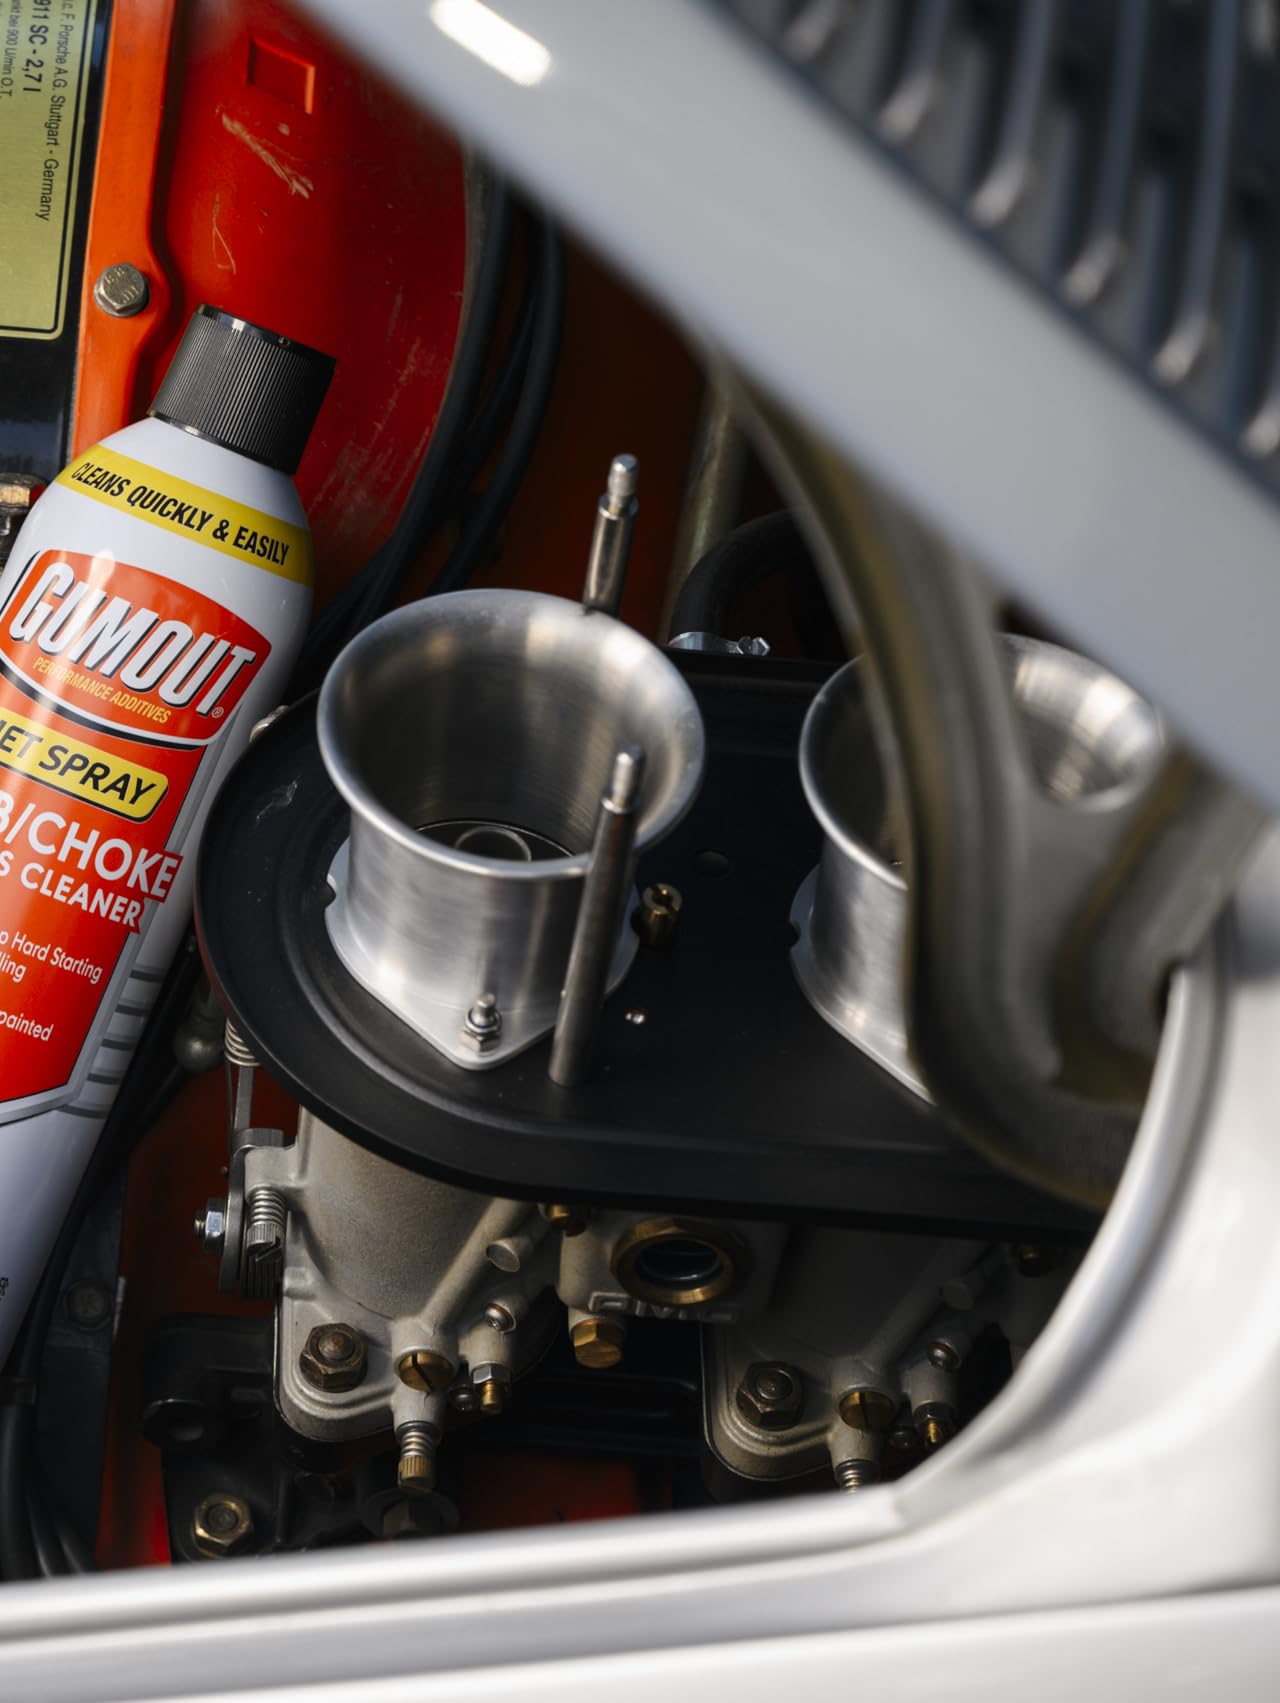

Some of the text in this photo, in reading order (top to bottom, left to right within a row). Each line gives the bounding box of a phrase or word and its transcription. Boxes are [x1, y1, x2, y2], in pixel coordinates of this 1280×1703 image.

[5, 29, 18, 45] 900
[28, 24, 49, 44] SC
[54, 24, 73, 64] Porsche
[21, 58, 44, 82] 2,7
[51, 67, 68, 90] A.G.
[42, 95, 65, 146] Stuttgart
[34, 158, 58, 220] Germany
[71, 458, 291, 566] CLEANS QUICKLY & EASILY
[8, 559, 257, 720] GUMOUT
[31, 656, 172, 725] PERFORMANCE ADDITIVES
[38, 743, 156, 804] SPRAY
[18, 859, 142, 928] CLEANER
[10, 931, 50, 961] Hard
[49, 946, 103, 984] Starting
